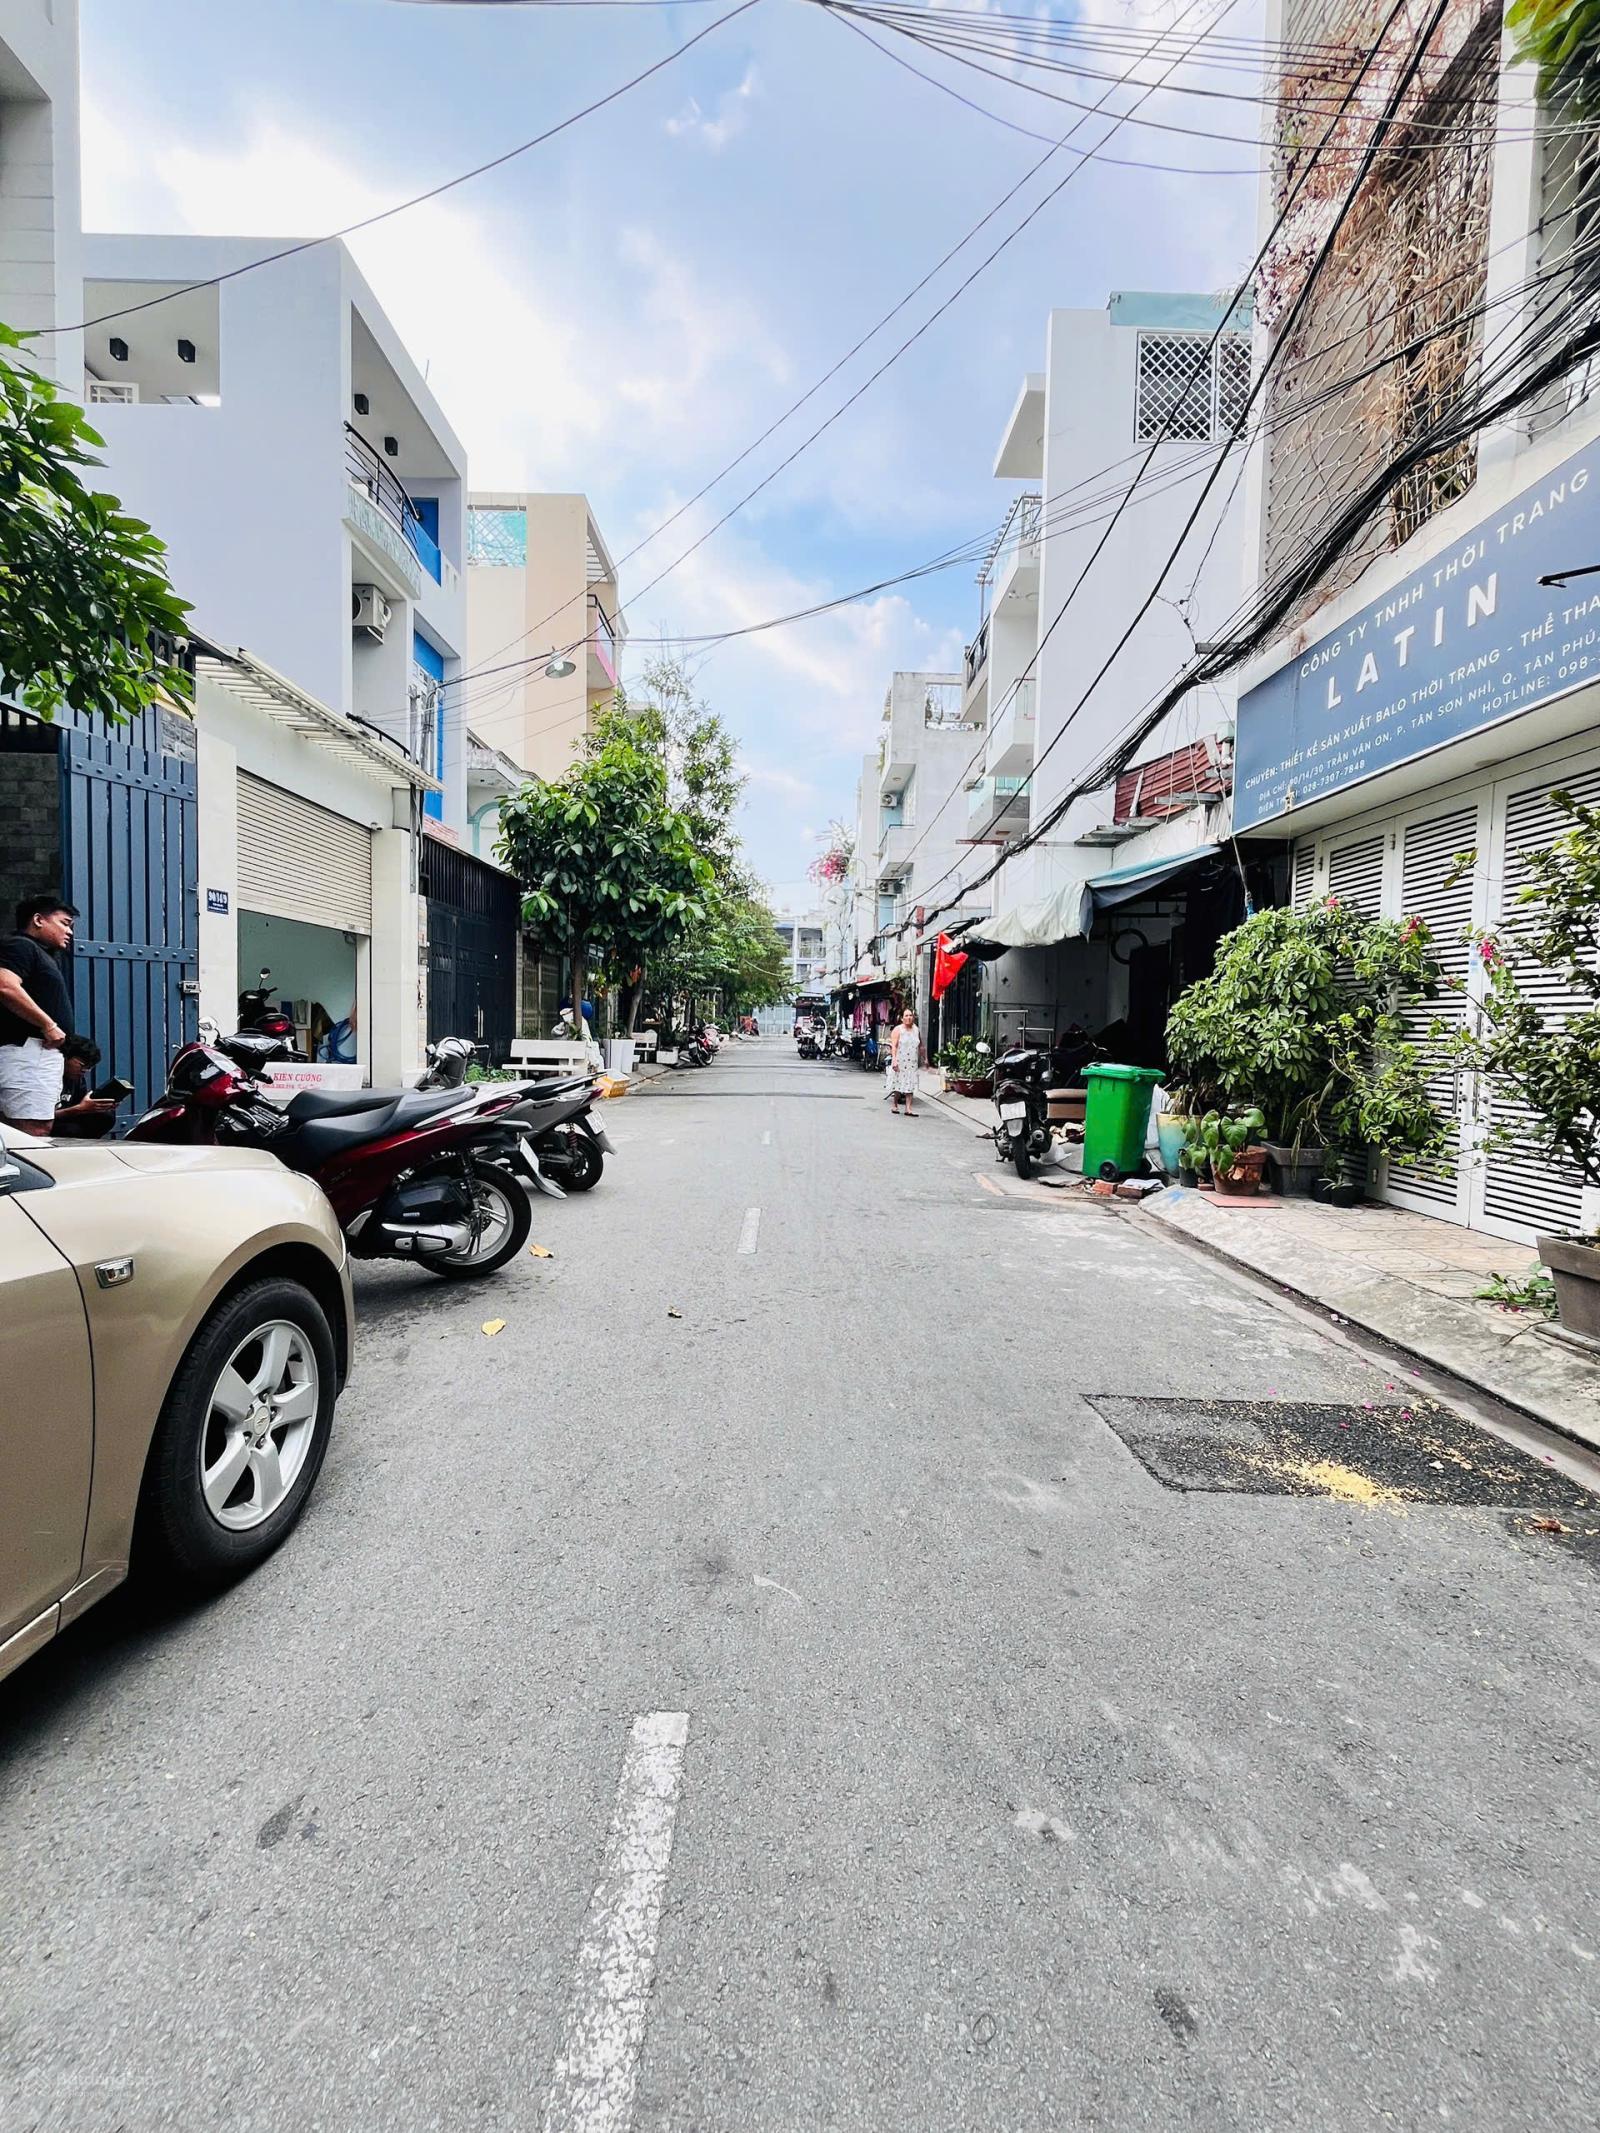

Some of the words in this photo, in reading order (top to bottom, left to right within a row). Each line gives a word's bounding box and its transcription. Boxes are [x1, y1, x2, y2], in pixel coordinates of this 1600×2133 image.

[1301, 644, 1341, 678] CÔNG
[1348, 622, 1368, 646] TY
[1375, 583, 1423, 628] TNHH
[1433, 540, 1485, 588] THỜI
[1497, 468, 1589, 544] TRANG
[1327, 572, 1497, 709] LATIN
[1245, 767, 1278, 789] CHUYÊN:
[1375, 698, 1407, 723] BALO
[1411, 678, 1443, 704] THỜI
[1448, 648, 1499, 685] TRANG
[1520, 612, 1554, 647] THỂ
[1397, 725, 1406, 737] P.
[1411, 711, 1433, 729] TÂN
[1502, 672, 1517, 686] Q.
[1524, 651, 1554, 674] TÂN
[1482, 675, 1550, 714] HOTLINE:
